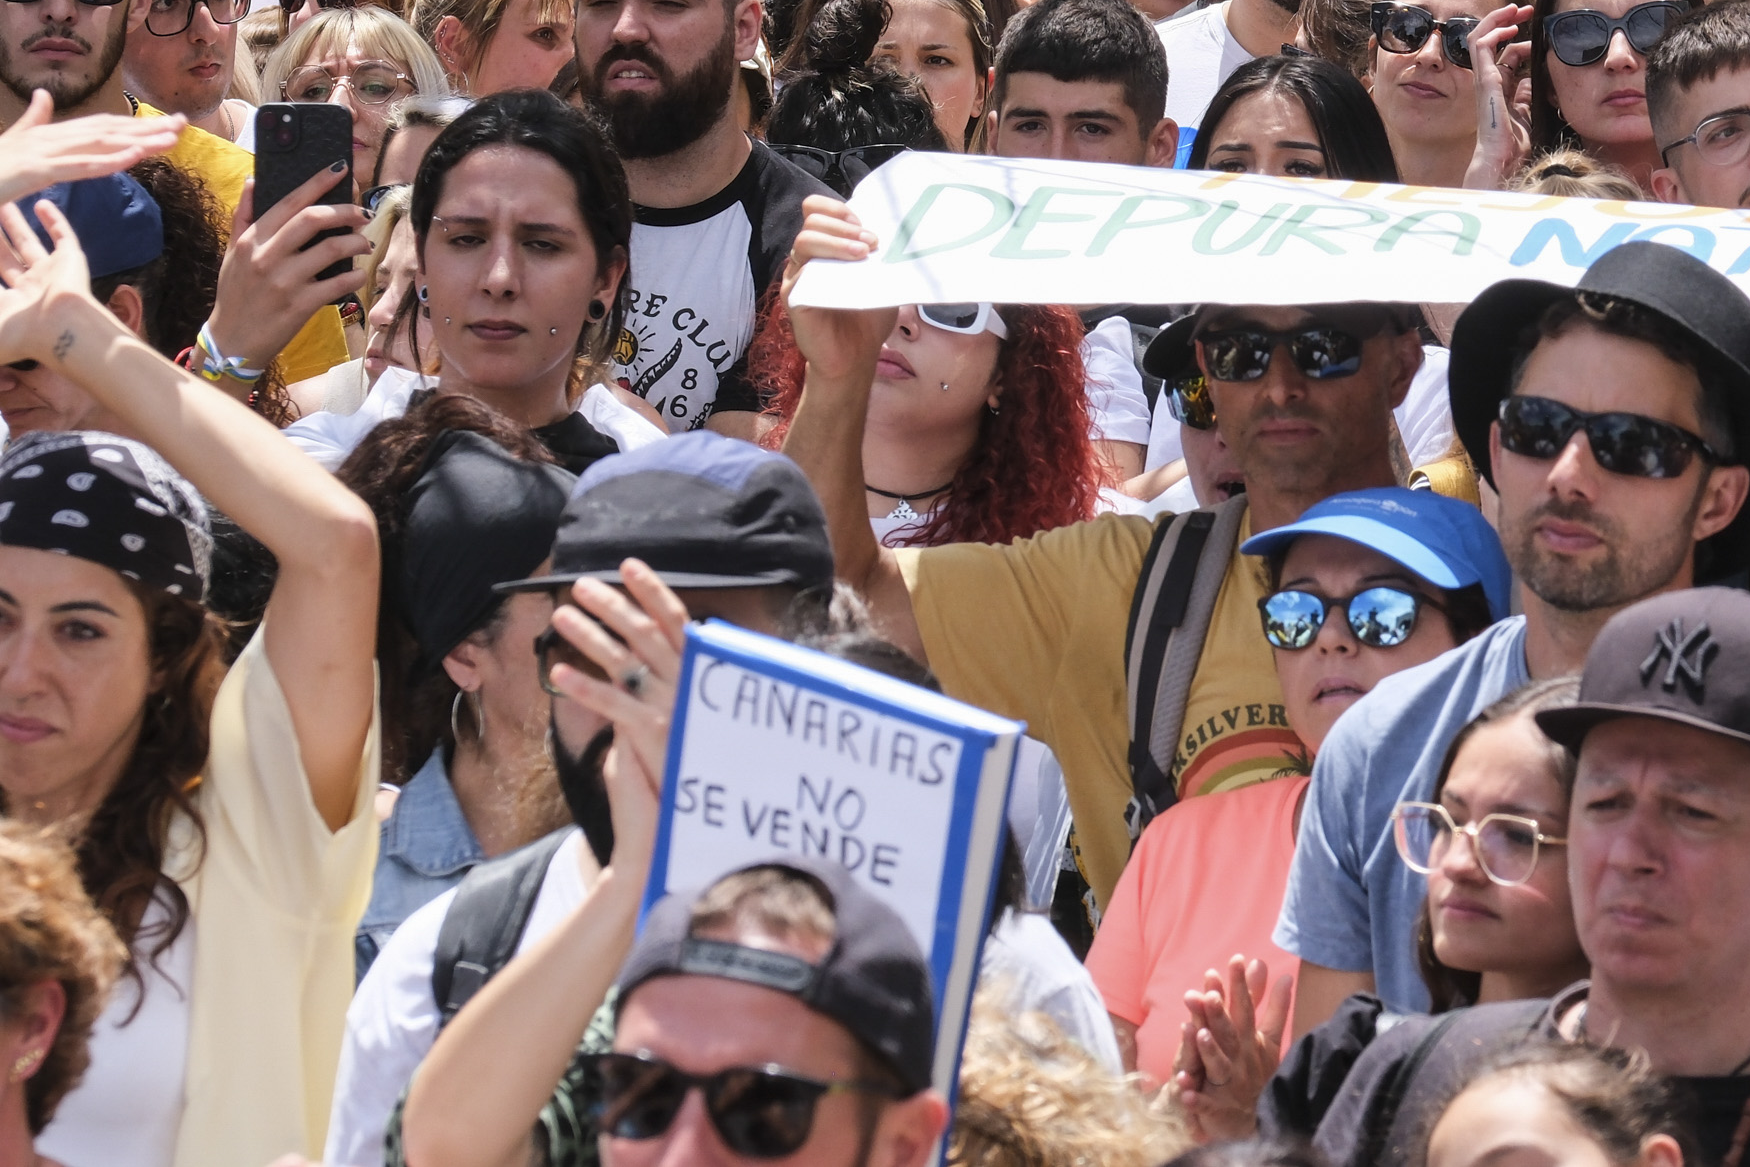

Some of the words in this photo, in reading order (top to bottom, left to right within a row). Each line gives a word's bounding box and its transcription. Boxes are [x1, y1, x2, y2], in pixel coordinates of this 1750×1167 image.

[880, 183, 1483, 264] DEPURA
[699, 659, 953, 786] CANARIAS
[674, 778, 726, 829] SE
[742, 799, 901, 886] VENDE
[798, 773, 866, 832] NO
